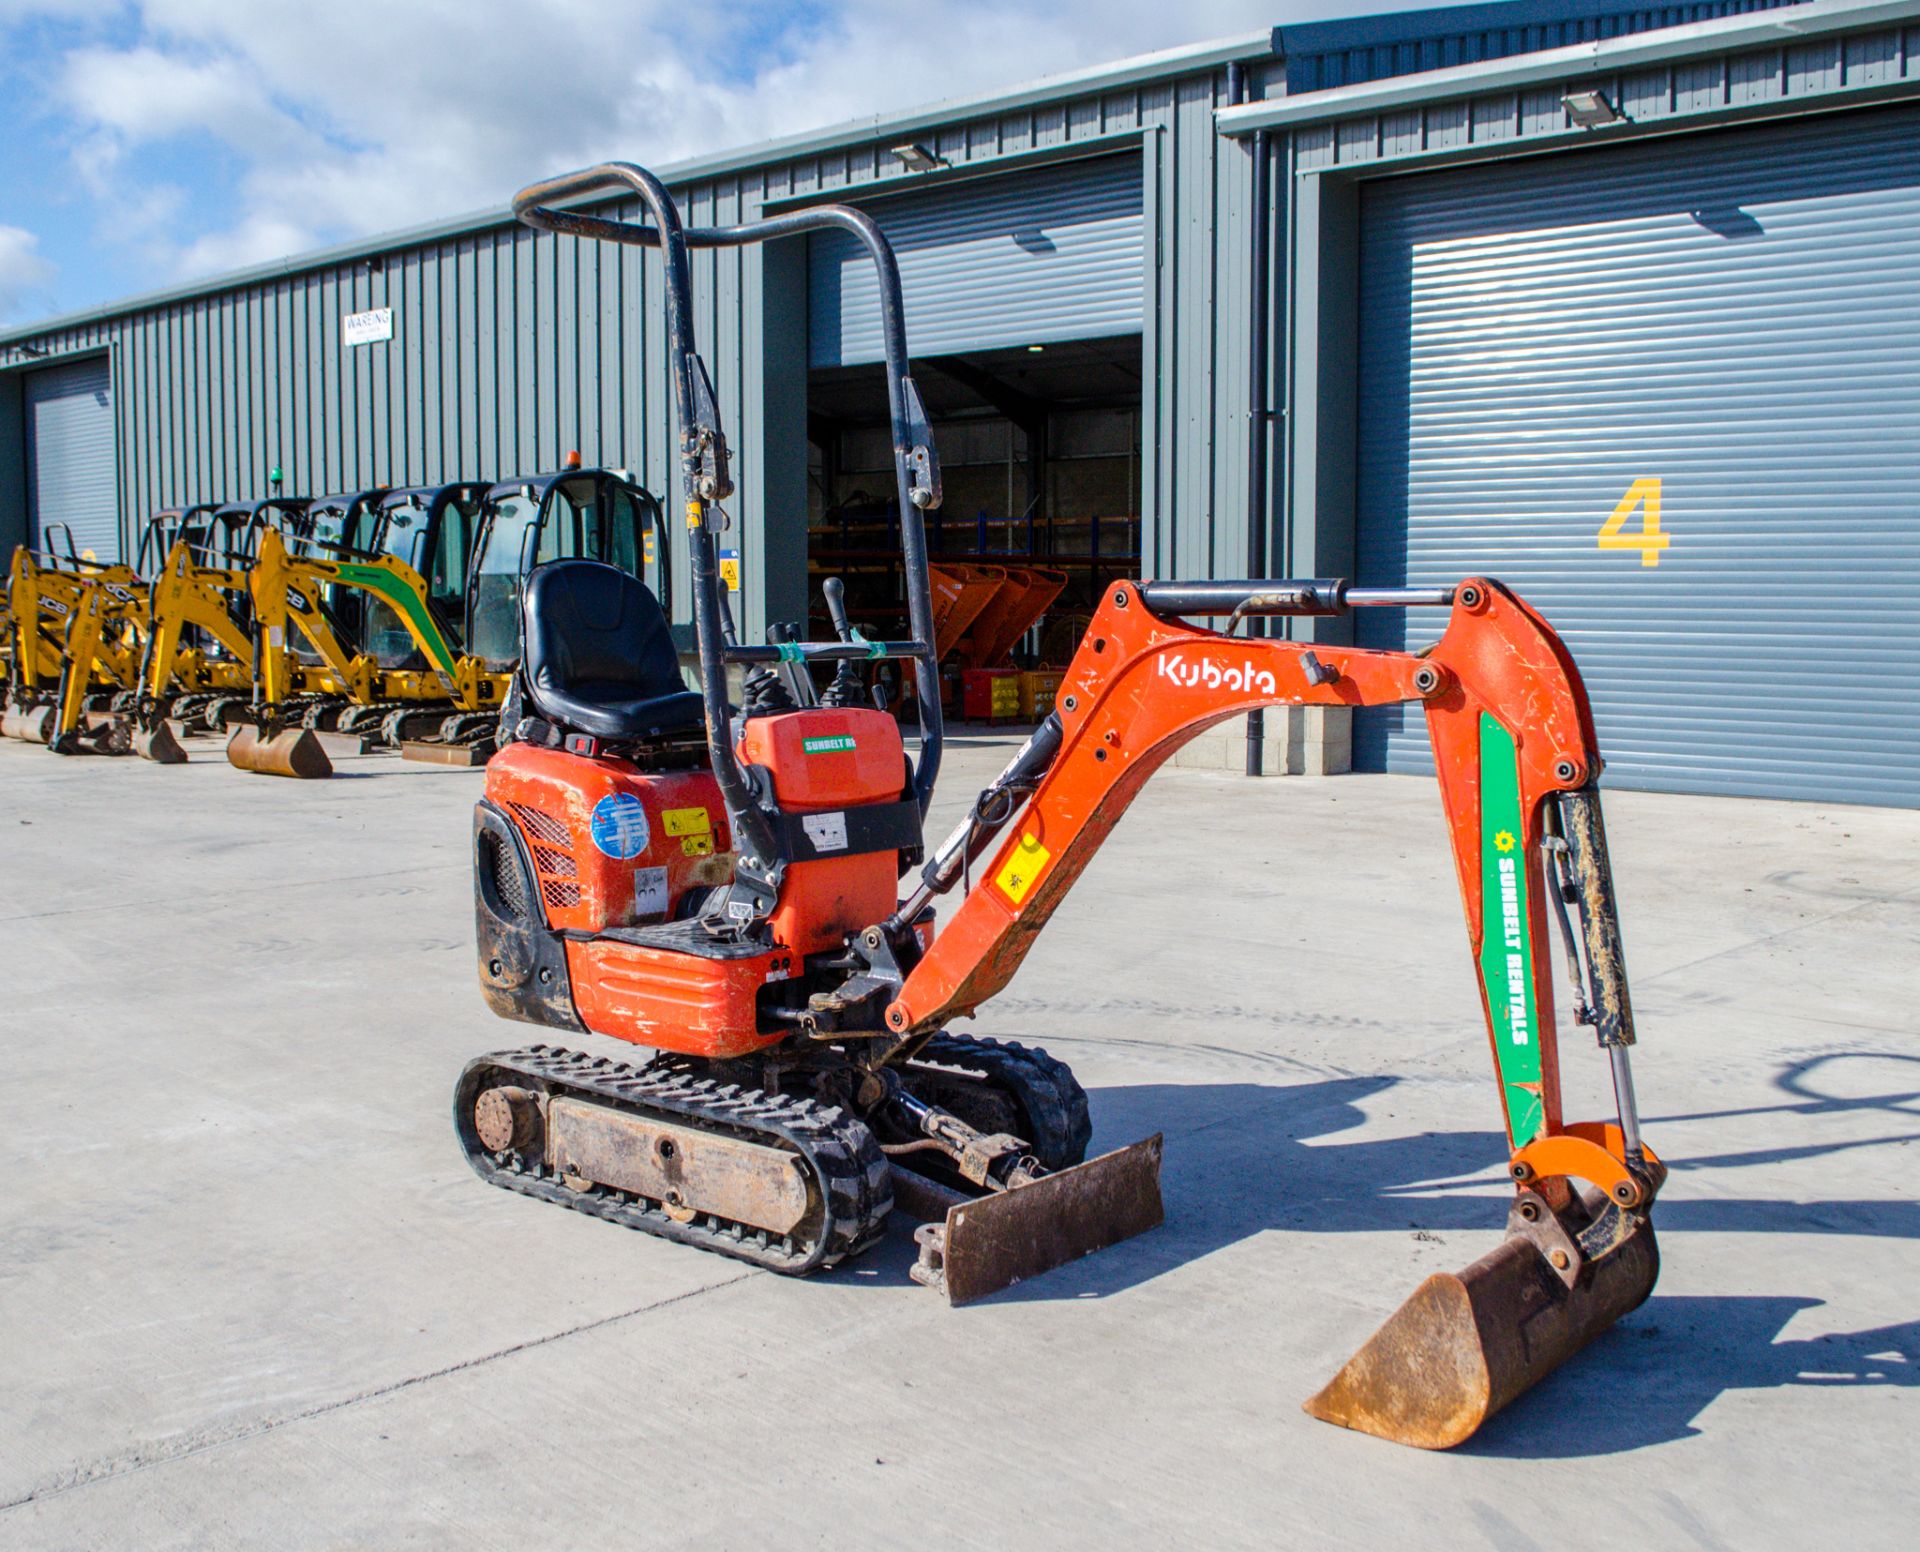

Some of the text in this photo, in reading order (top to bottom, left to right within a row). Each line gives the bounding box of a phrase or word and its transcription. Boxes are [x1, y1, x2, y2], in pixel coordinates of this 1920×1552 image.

[347, 310, 389, 328] WARENG
[1598, 478, 1670, 567] 4
[38, 595, 68, 615] JCB
[1158, 654, 1276, 694] Kubota
[805, 740, 843, 751] SUNBELT
[1499, 858, 1528, 1045] SUNBELT RENTALS
